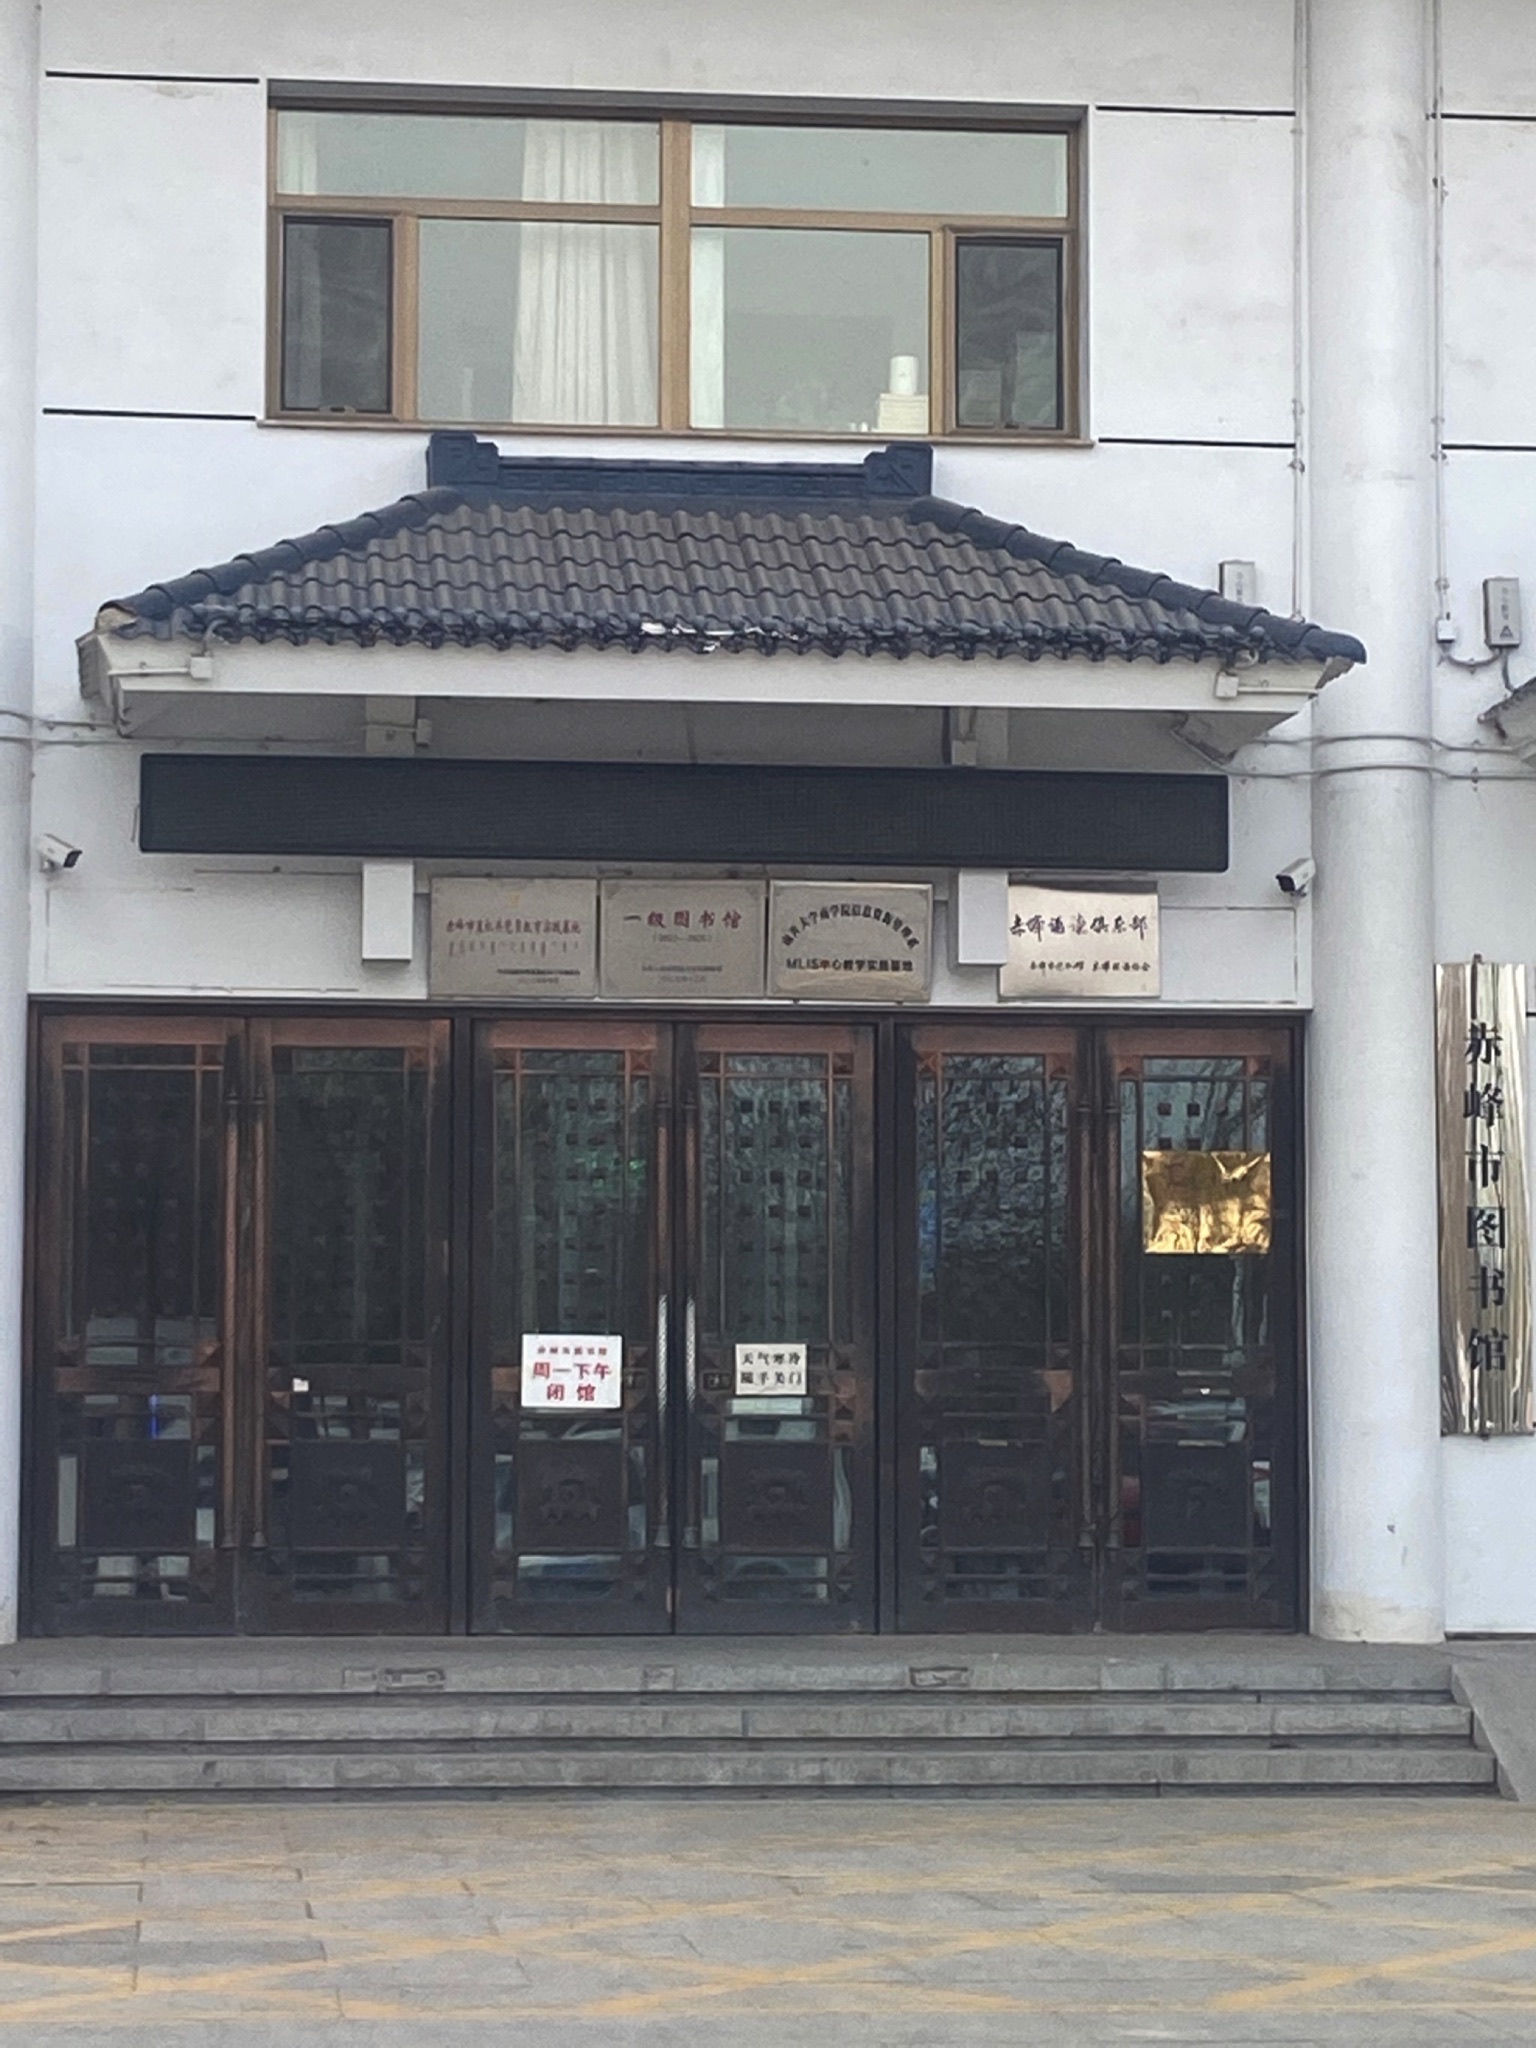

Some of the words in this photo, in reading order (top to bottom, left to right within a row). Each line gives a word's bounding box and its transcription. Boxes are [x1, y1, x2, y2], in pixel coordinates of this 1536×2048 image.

[623, 910, 742, 929] 一级图书馆
[1463, 1022, 1509, 1372] 赤峰市图书馆
[742, 1351, 801, 1366] 天气寒冷
[532, 1361, 612, 1381] 周一下午
[740, 1370, 802, 1386] 随手关门
[546, 1383, 596, 1402] 闭馆
